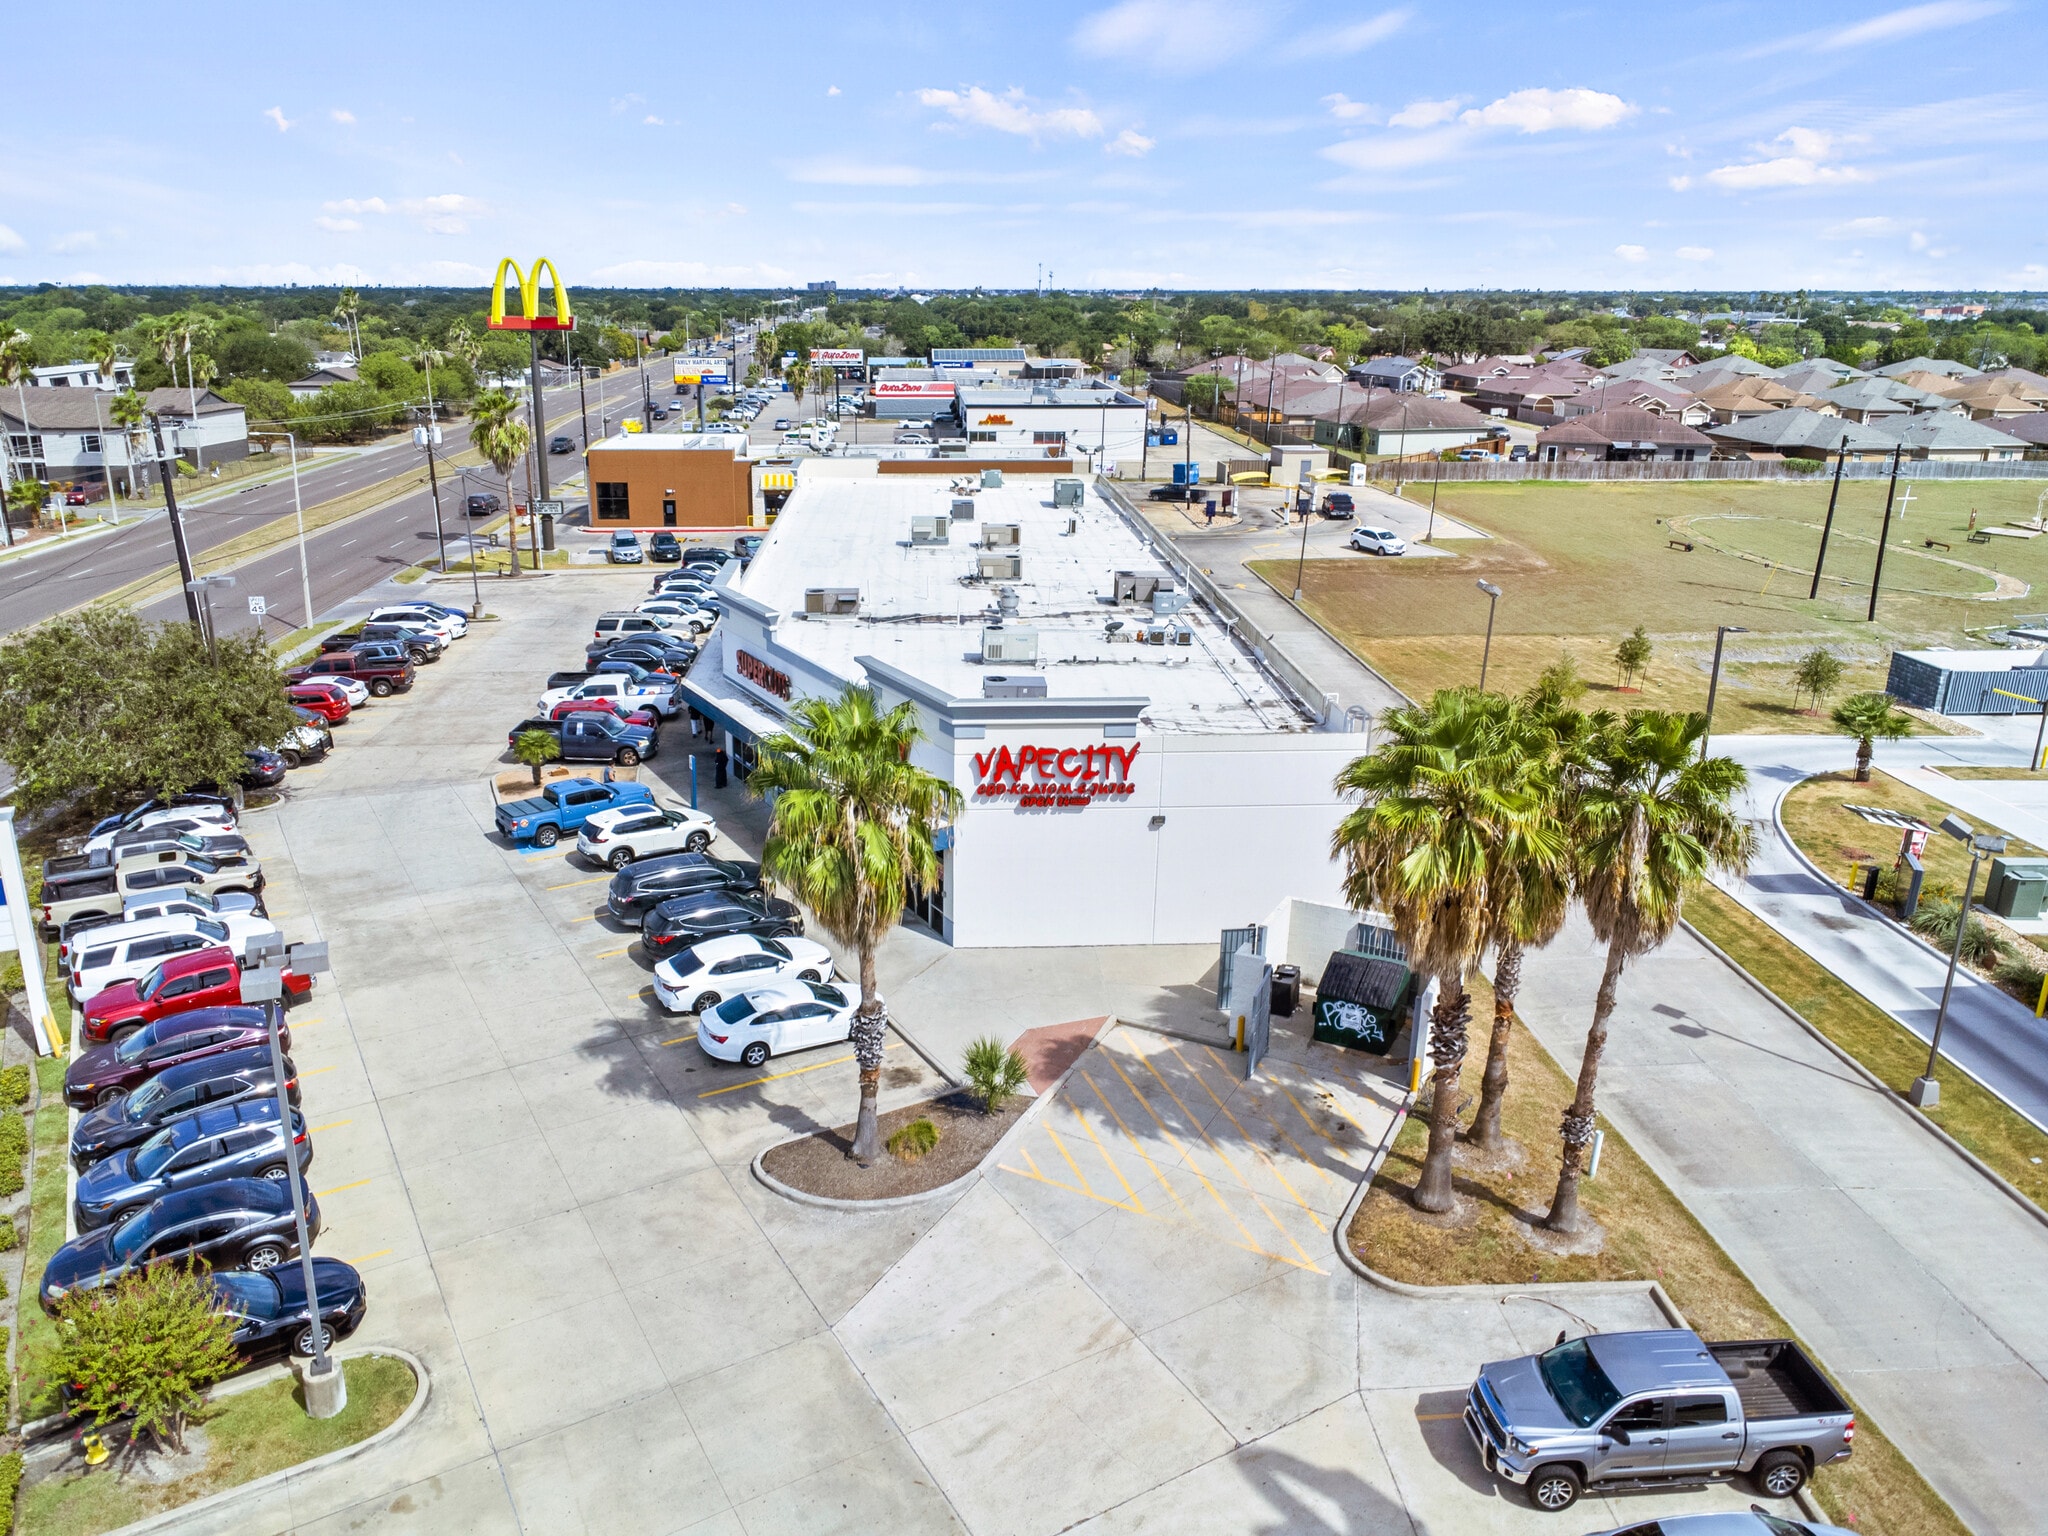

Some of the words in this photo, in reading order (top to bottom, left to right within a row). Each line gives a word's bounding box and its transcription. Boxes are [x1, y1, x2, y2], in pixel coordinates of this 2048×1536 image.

[822, 351, 860, 359] AutoZone
[879, 383, 922, 392] AutoZone
[736, 649, 792, 702] SUPERCUTS
[1020, 795, 1055, 807] OPEN
